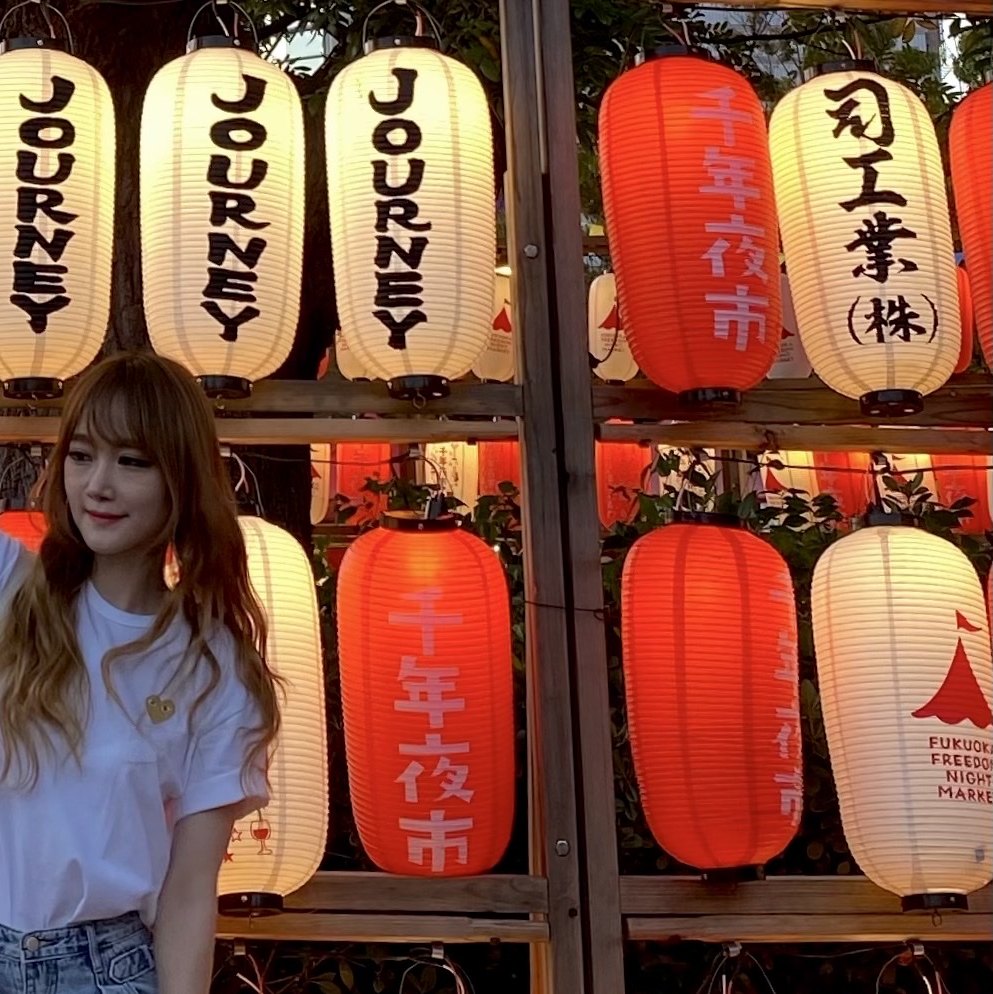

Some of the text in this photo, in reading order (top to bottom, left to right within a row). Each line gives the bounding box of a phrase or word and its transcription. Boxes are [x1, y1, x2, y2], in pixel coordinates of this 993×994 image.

[10, 75, 79, 333] JOURNEY
[200, 73, 271, 342] JOURNEY
[369, 67, 432, 350] JOURNEY
[690, 86, 769, 351] 千年夜市
[388, 586, 475, 873] 千年夜市
[929, 736, 993, 755] FUKUOK
[931, 753, 993, 771] FREEDO
[946, 770, 992, 787] NIGHT
